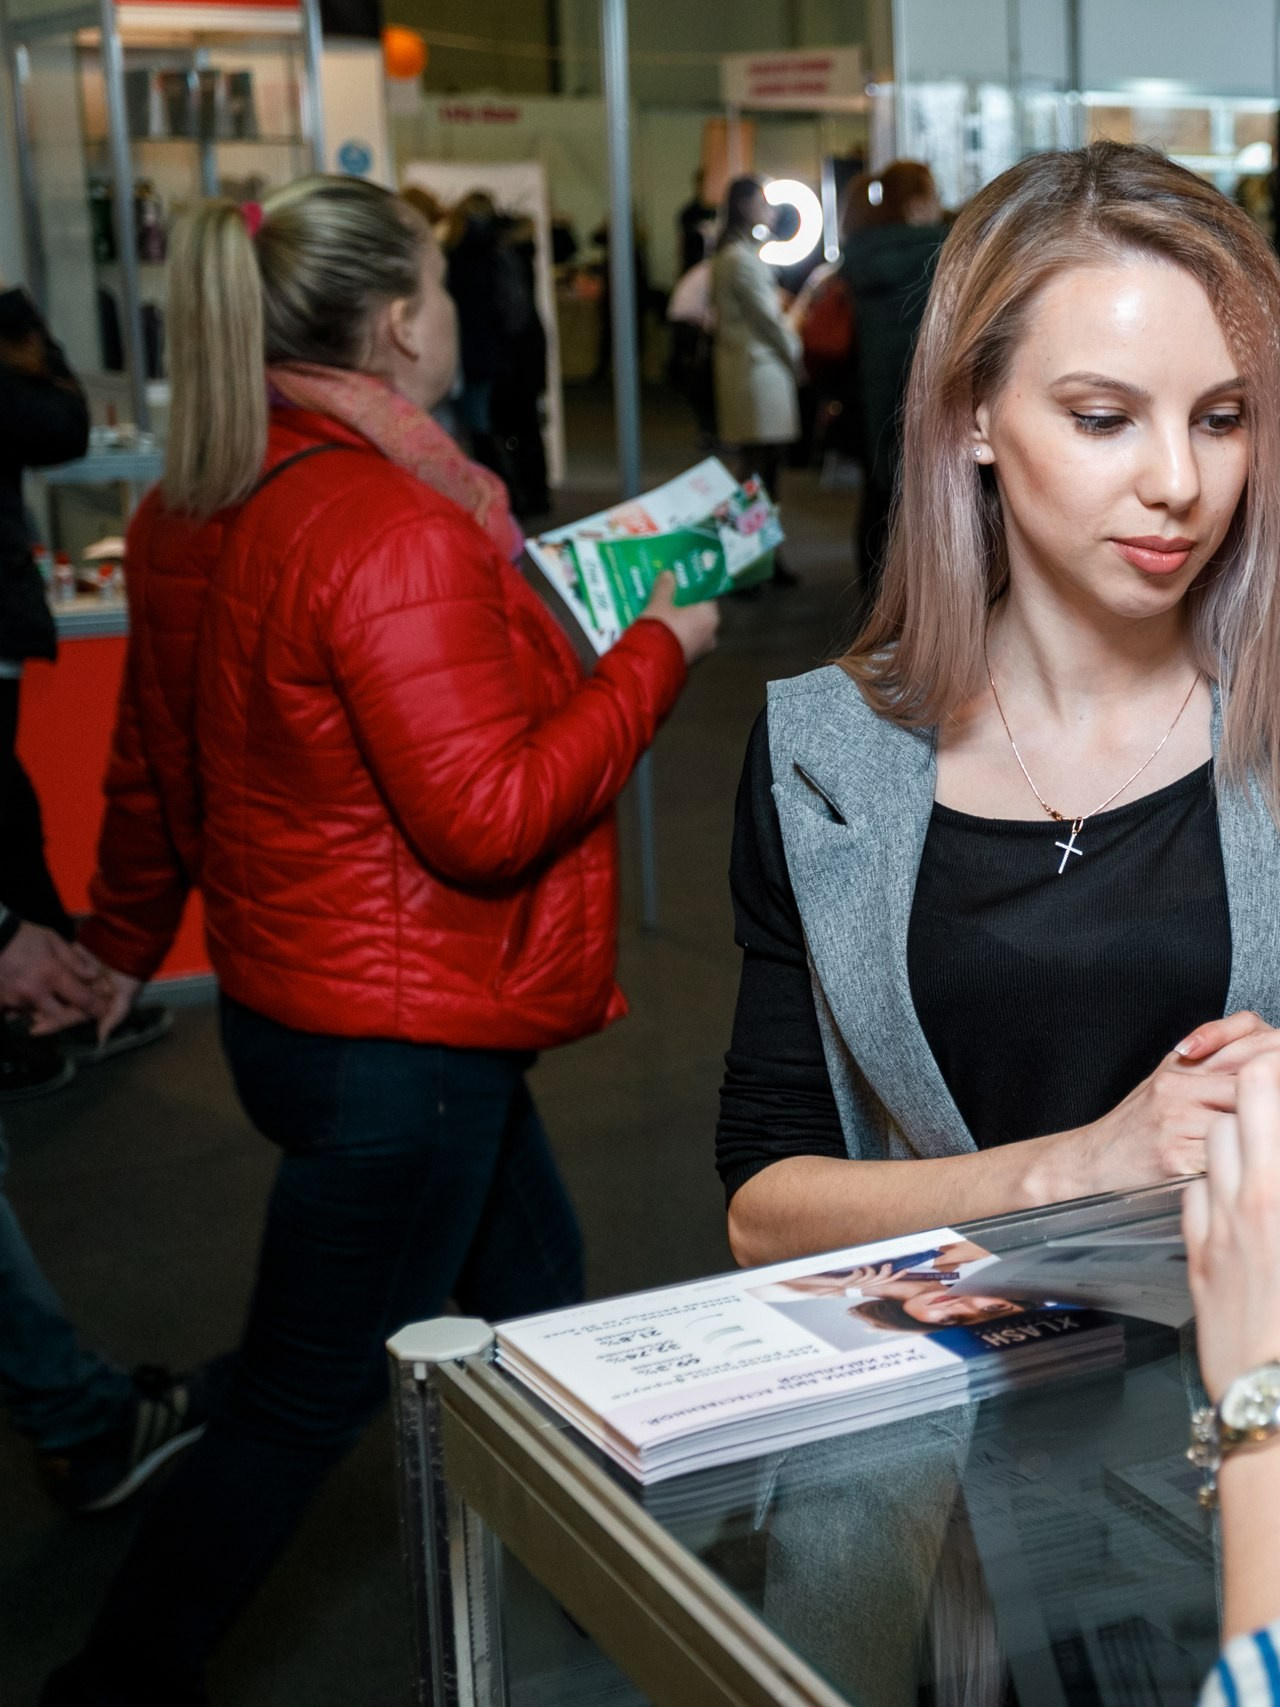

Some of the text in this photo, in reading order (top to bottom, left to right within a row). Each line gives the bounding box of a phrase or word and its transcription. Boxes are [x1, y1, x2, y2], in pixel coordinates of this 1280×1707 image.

[980, 1315, 1080, 1348] XLASH
[880, 1351, 902, 1361] НЕ
[906, 1352, 927, 1364] ТЫ
[776, 1356, 878, 1386] ИДЕАЛЬНОЙ
[821, 1358, 901, 1384] РОЖДЕНА
[776, 1378, 819, 1392] БЫТЬ
